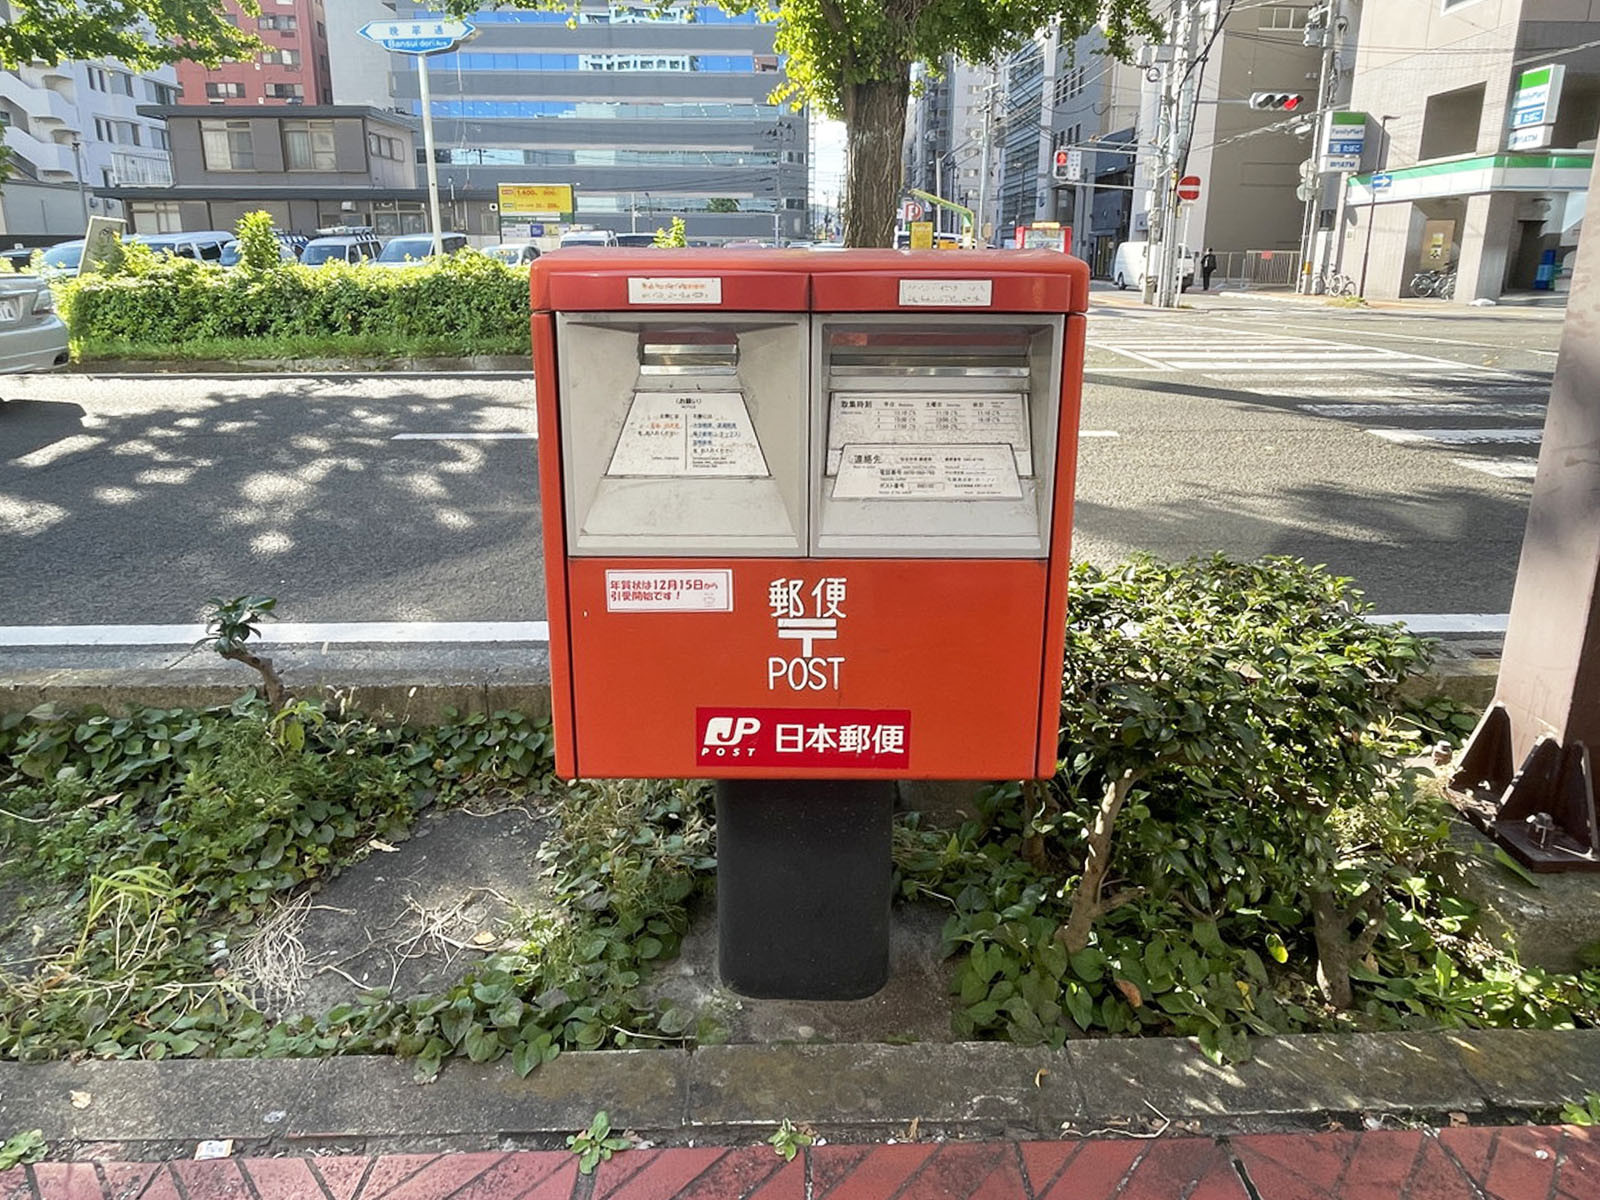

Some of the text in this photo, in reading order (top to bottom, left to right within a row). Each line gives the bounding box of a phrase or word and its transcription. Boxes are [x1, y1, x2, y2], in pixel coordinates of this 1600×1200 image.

[610, 579, 718, 590] 年賀状は12月15日から
[768, 577, 847, 618] 郵便
[768, 657, 845, 690] POST
[701, 747, 756, 757] POST
[775, 723, 904, 753] 日本郵便
